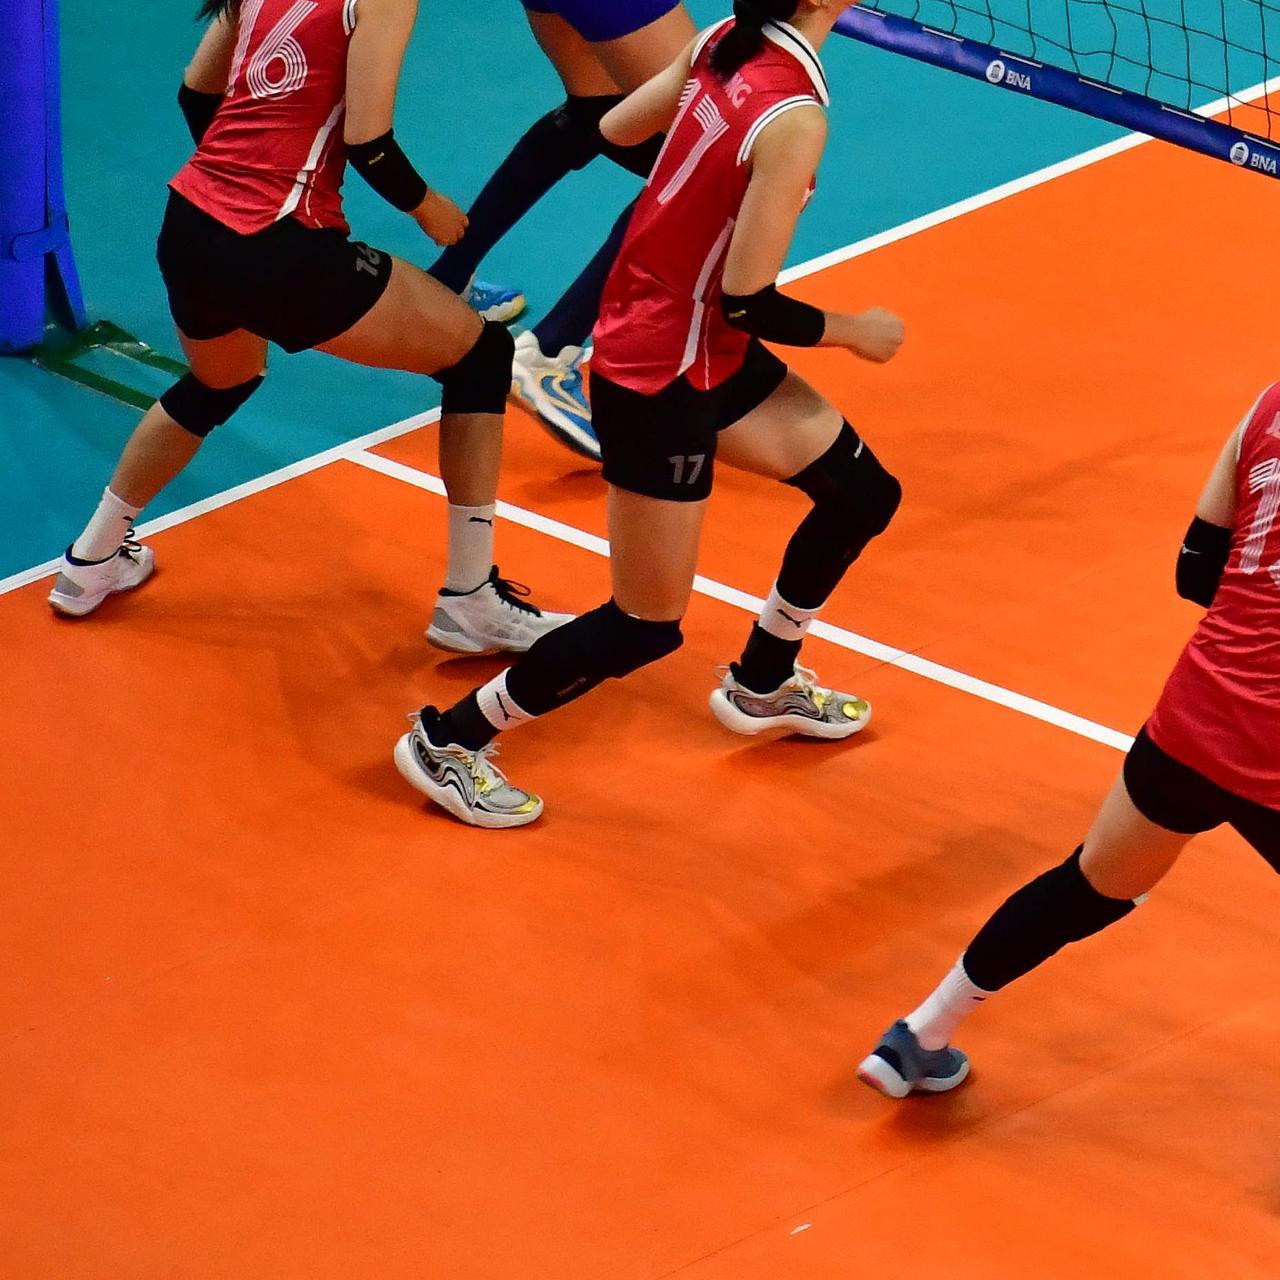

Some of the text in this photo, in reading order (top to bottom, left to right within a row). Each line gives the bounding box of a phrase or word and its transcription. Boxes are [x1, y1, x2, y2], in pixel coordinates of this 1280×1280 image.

[1006, 70, 1030, 90] BNA
[646, 78, 731, 206] 17
[1251, 153, 1276, 173] BNA
[668, 454, 706, 485] 17
